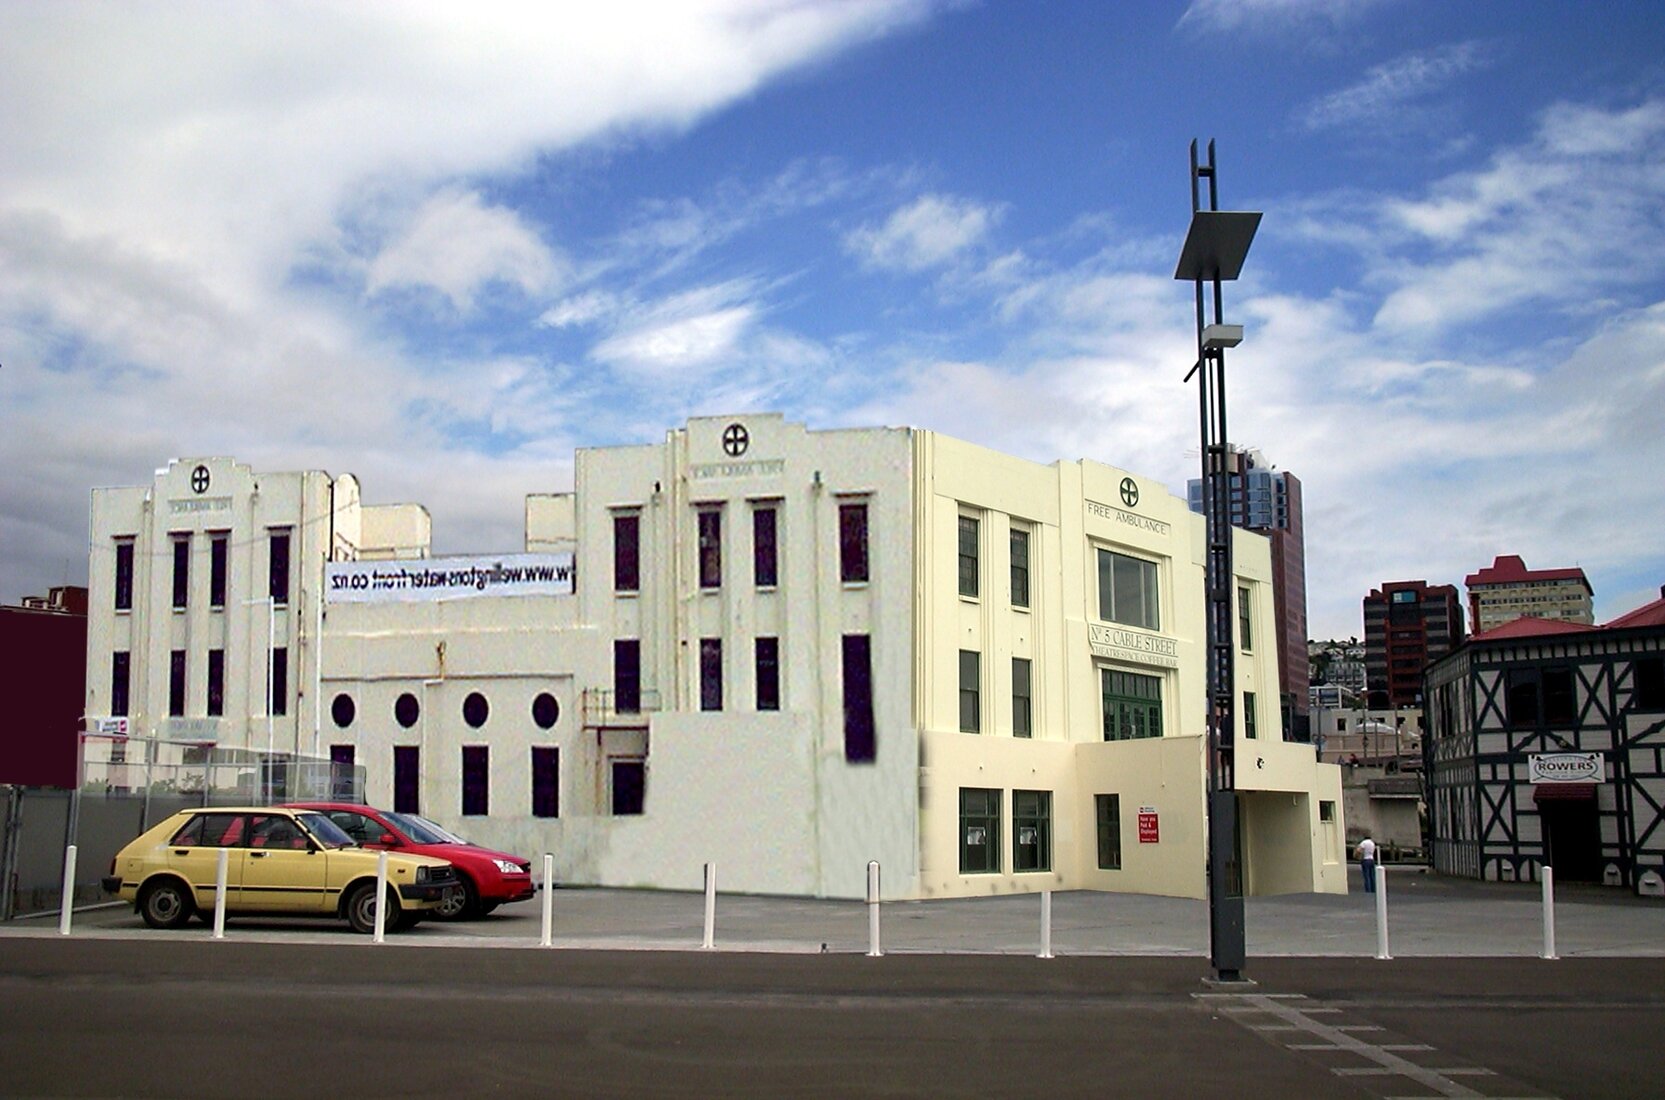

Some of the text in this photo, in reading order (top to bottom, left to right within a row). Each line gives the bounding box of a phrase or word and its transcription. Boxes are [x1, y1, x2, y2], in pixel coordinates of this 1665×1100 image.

[1087, 503, 1167, 535] FREE AMBULANCE
[1104, 629, 1111, 643] 5
[1112, 631, 1142, 649] CABLE
[1144, 637, 1177, 655] STREET
[1538, 762, 1594, 771] ROWERS
